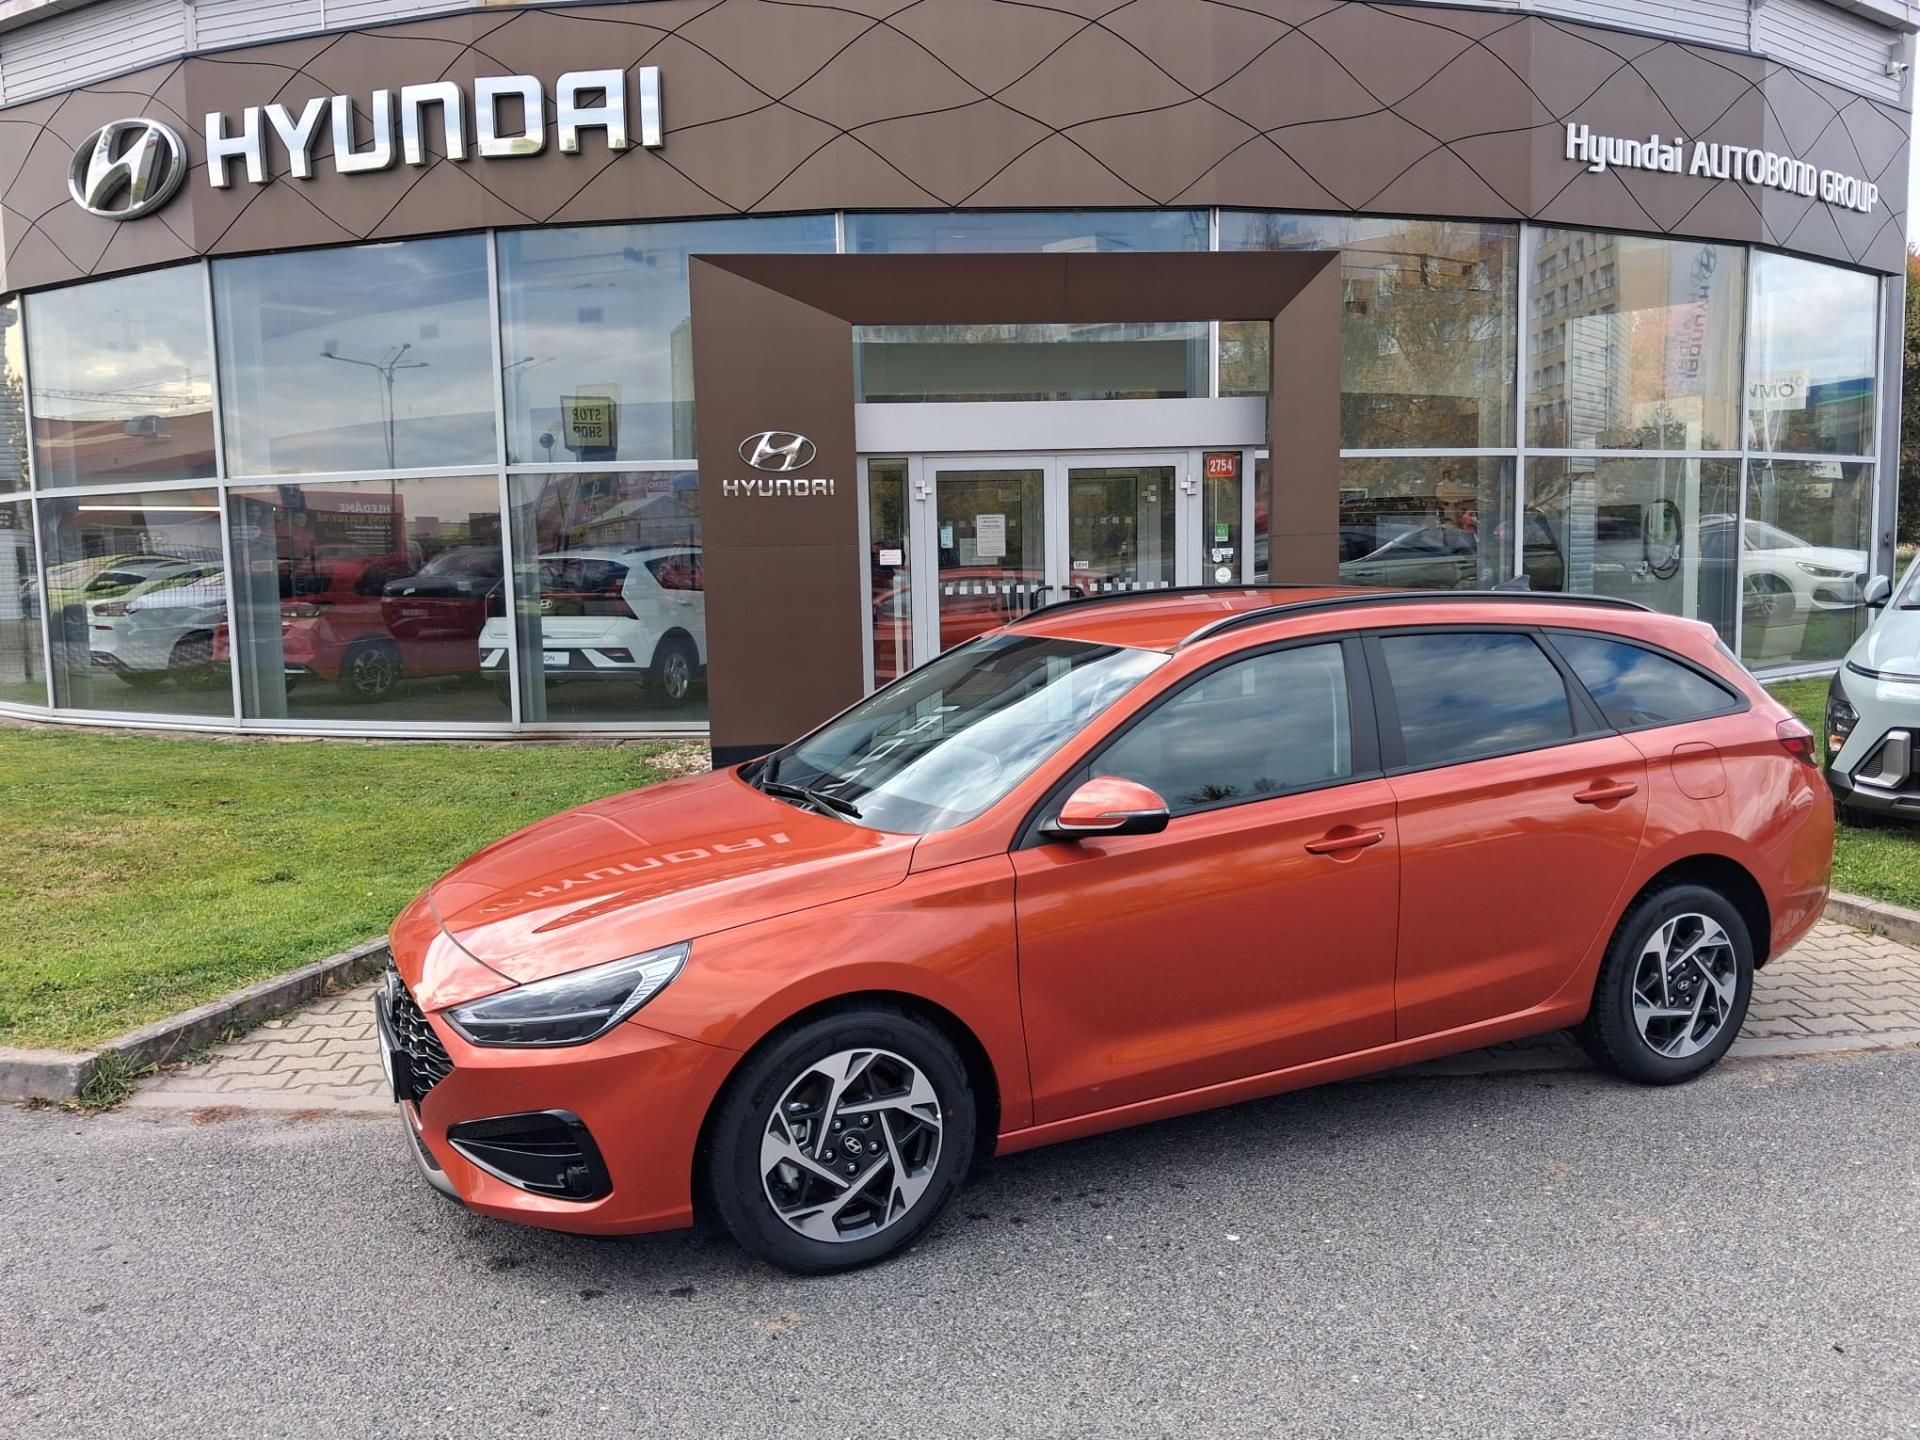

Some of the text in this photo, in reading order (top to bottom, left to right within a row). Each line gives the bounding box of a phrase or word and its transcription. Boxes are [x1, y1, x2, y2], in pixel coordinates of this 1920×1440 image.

[205, 65, 664, 189] HYUNDAI
[1566, 122, 1879, 214] Hyundai AUTOBOND GROUP
[723, 479, 835, 497] HYUNDAI
[1209, 458, 1233, 473] 2754
